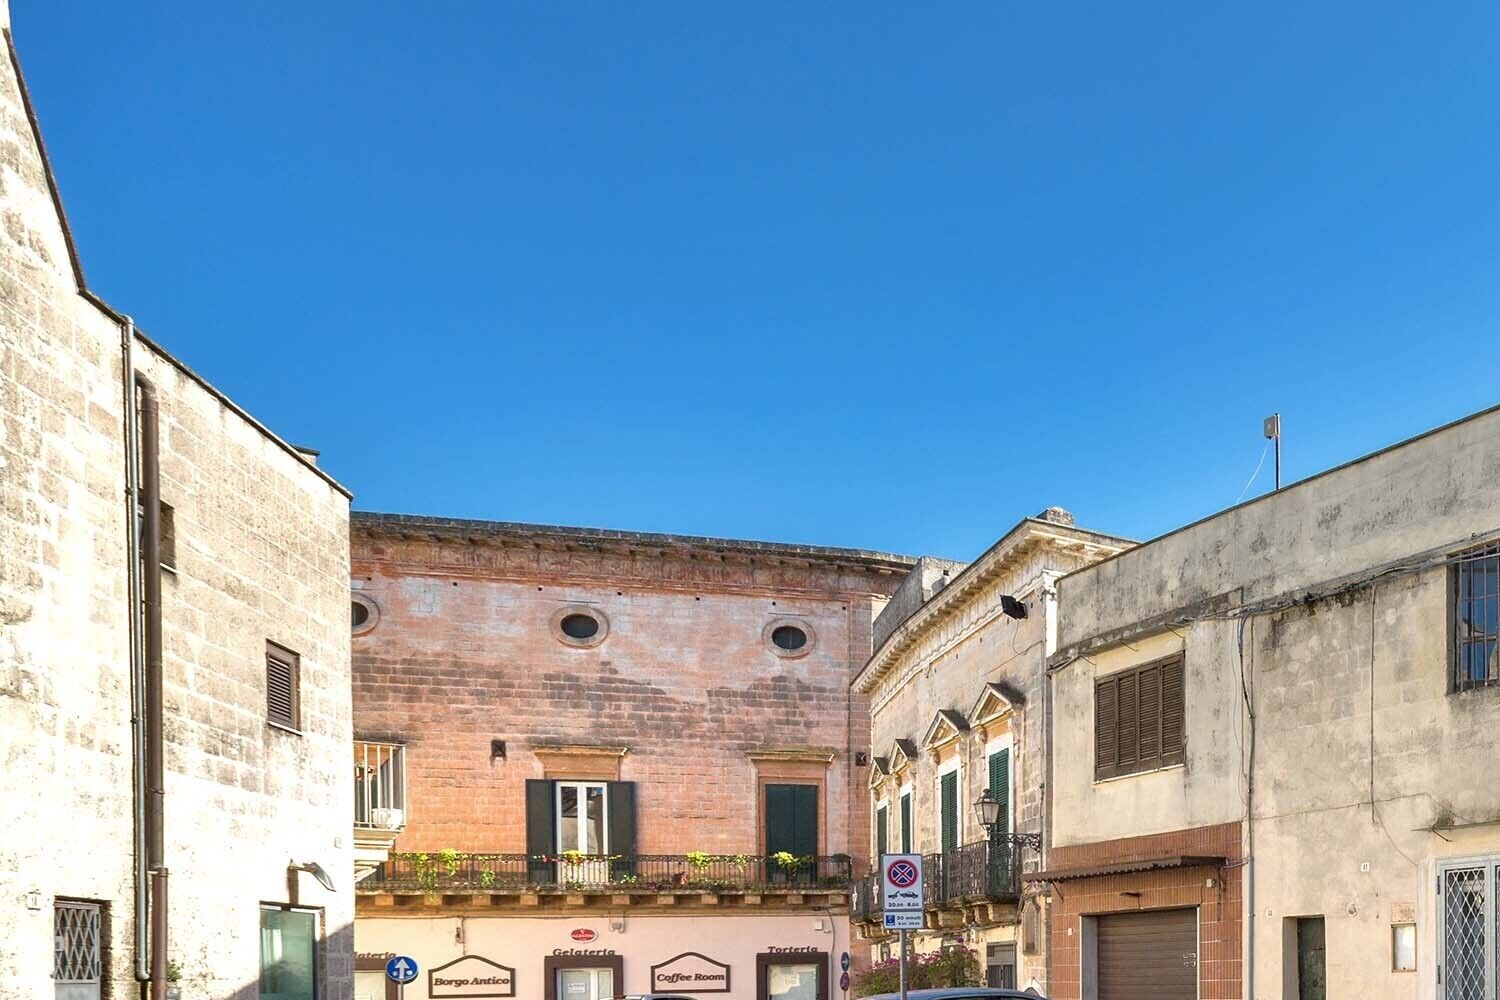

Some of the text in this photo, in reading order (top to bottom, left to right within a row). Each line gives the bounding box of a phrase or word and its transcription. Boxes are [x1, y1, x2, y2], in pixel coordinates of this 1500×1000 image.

[552, 948, 616, 957] Gelateria
[767, 945, 818, 953] Torteria
[433, 976, 510, 987] Borgo Antico
[656, 973, 725, 983] Coffee Room
